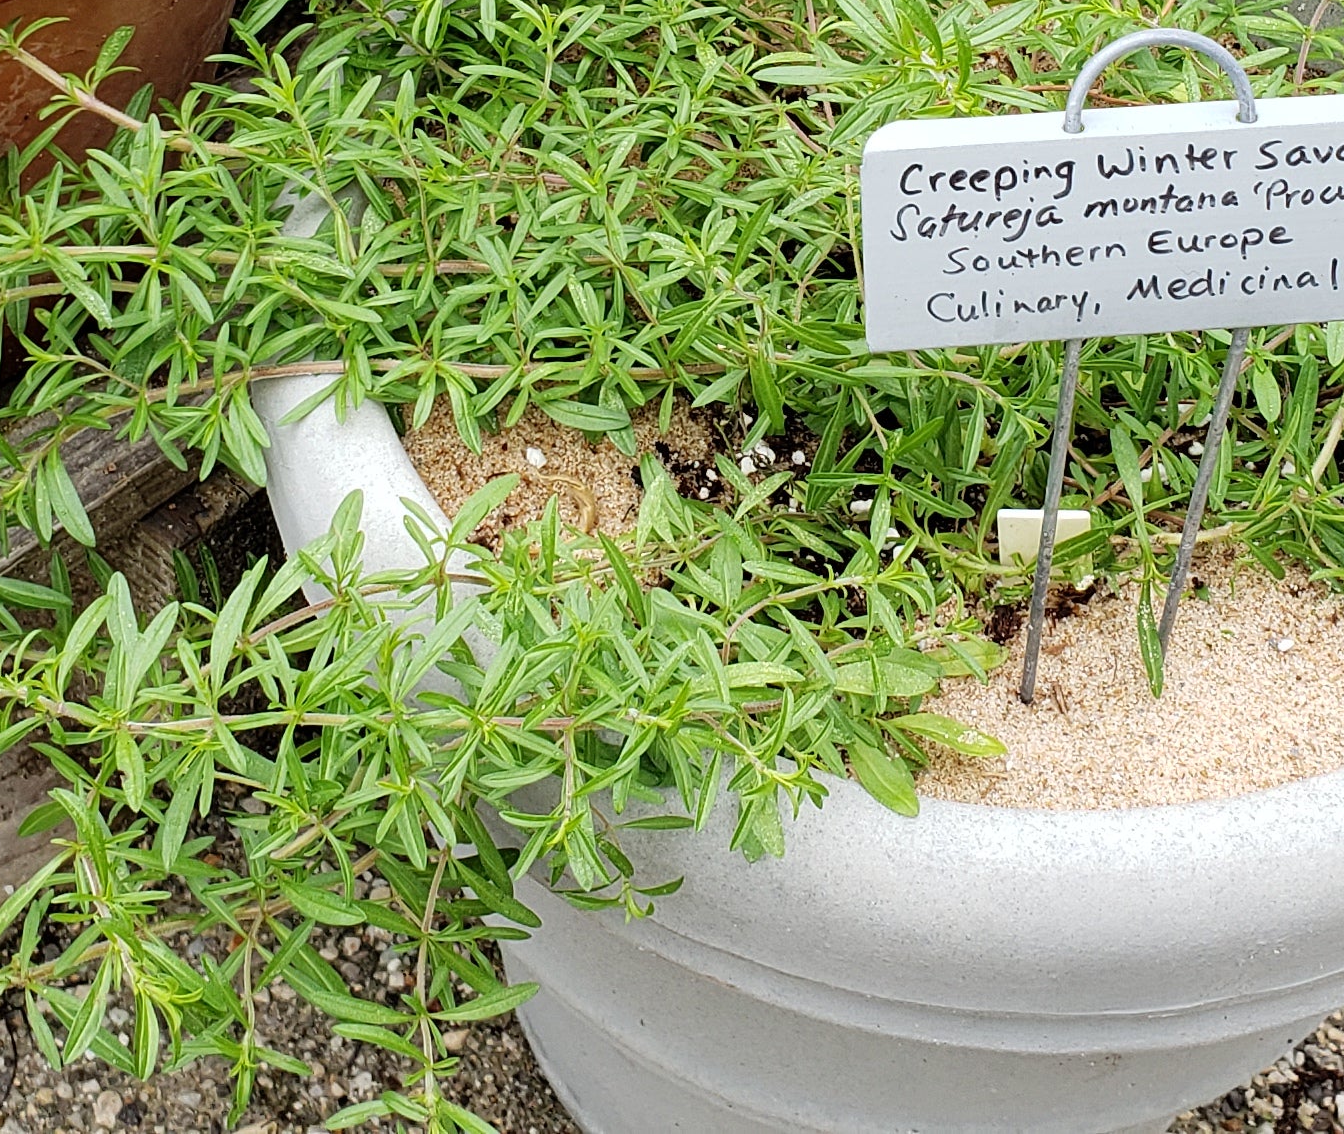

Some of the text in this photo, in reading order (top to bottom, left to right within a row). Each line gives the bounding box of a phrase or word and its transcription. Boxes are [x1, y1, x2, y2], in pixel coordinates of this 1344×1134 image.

[899, 158, 1076, 200] Creeping
[1097, 143, 1238, 180] Winter
[890, 201, 1064, 243] Satureja
[1083, 183, 1240, 219] montana
[942, 227, 1295, 276] Southern Europe
[926, 257, 1339, 323] Culinary, Medicinal
